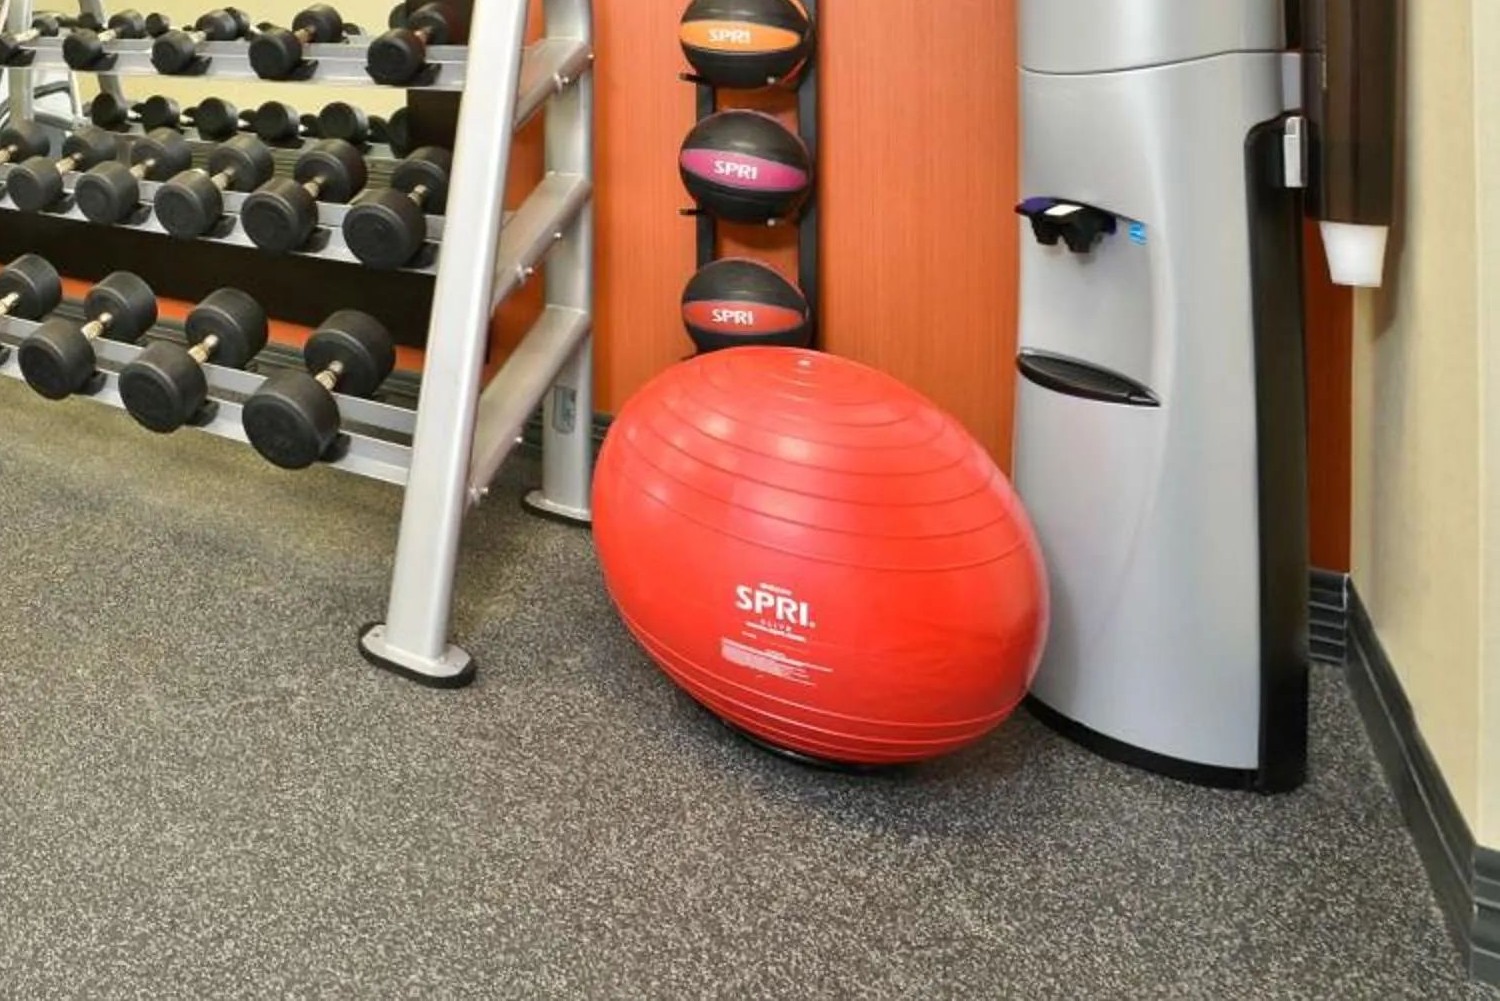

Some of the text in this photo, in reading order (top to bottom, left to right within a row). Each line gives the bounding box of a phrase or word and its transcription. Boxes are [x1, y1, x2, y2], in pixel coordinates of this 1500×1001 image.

[708, 28, 750, 44] SPRI
[713, 160, 757, 180] SPRI
[711, 309, 753, 326] SPRI
